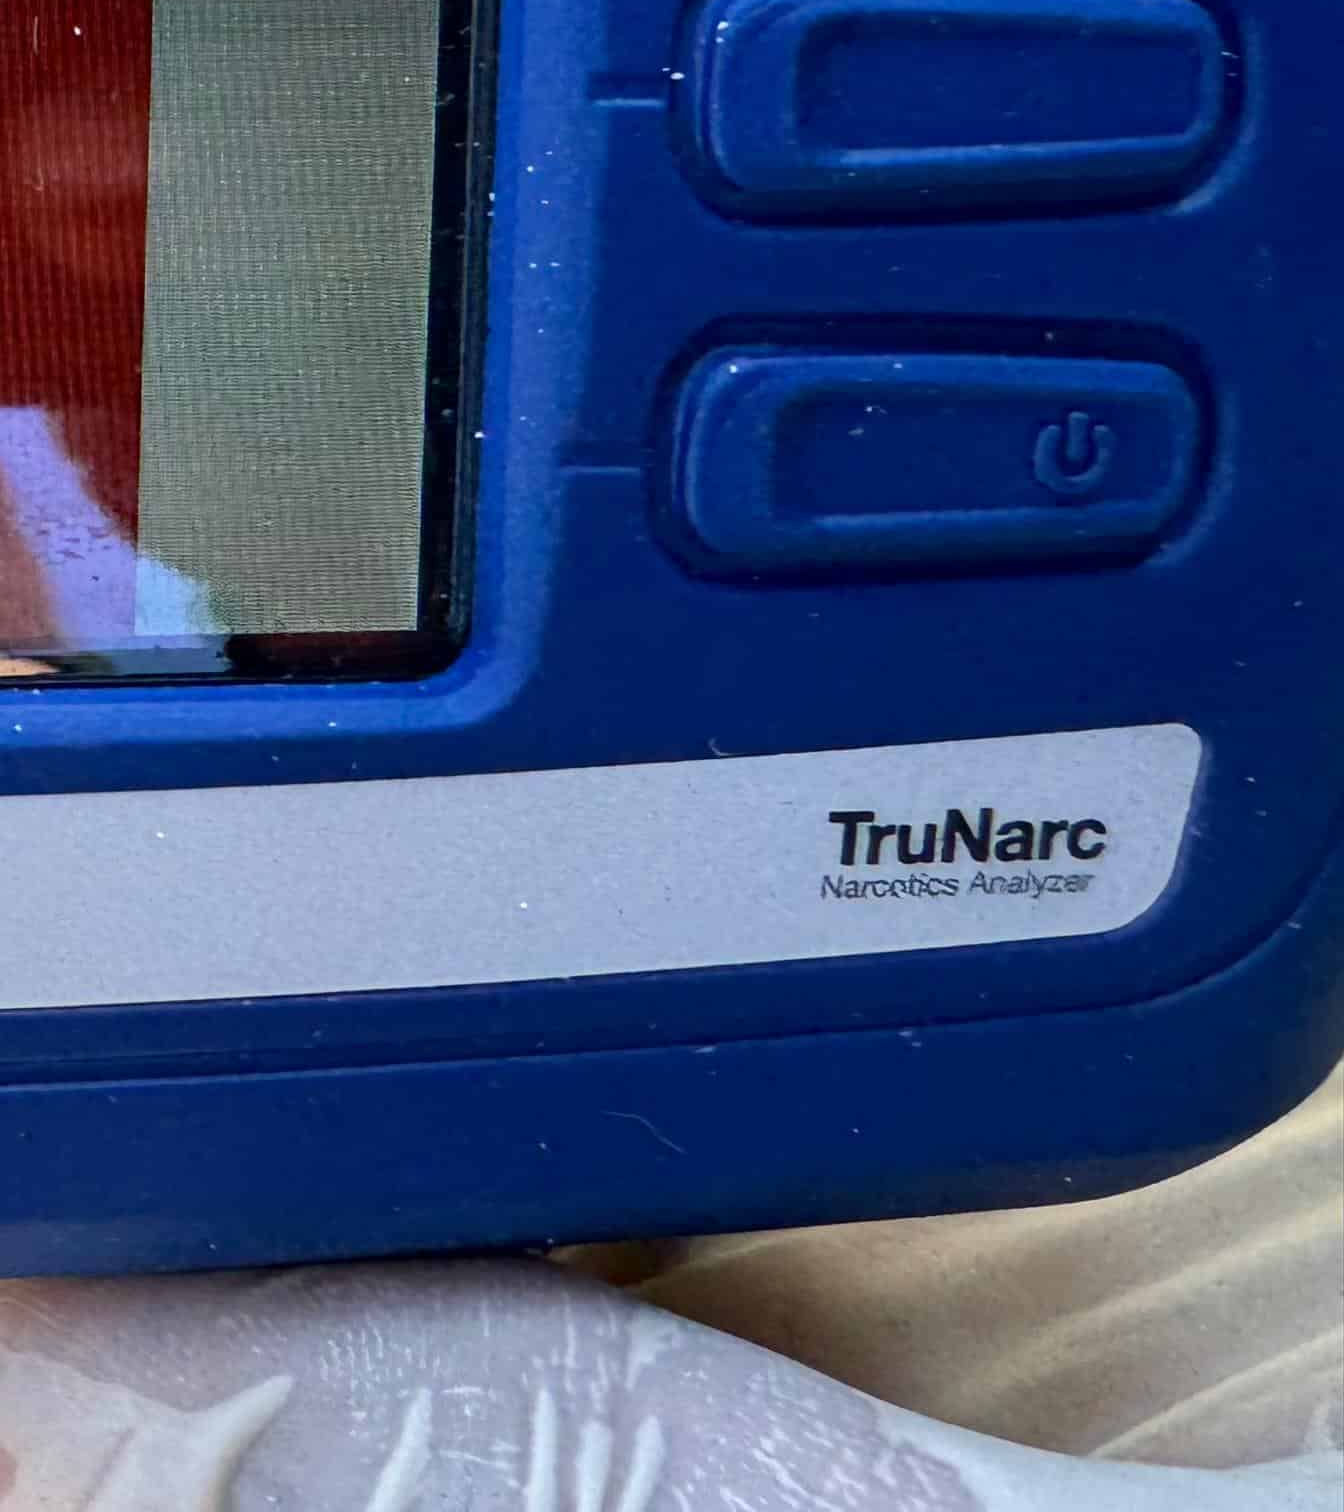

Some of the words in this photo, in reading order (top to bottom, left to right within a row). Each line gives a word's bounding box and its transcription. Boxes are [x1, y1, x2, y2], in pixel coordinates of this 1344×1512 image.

[828, 807, 1108, 866] TruNarc
[819, 872, 961, 900] Narcotics
[968, 868, 1097, 899] Analyzer
